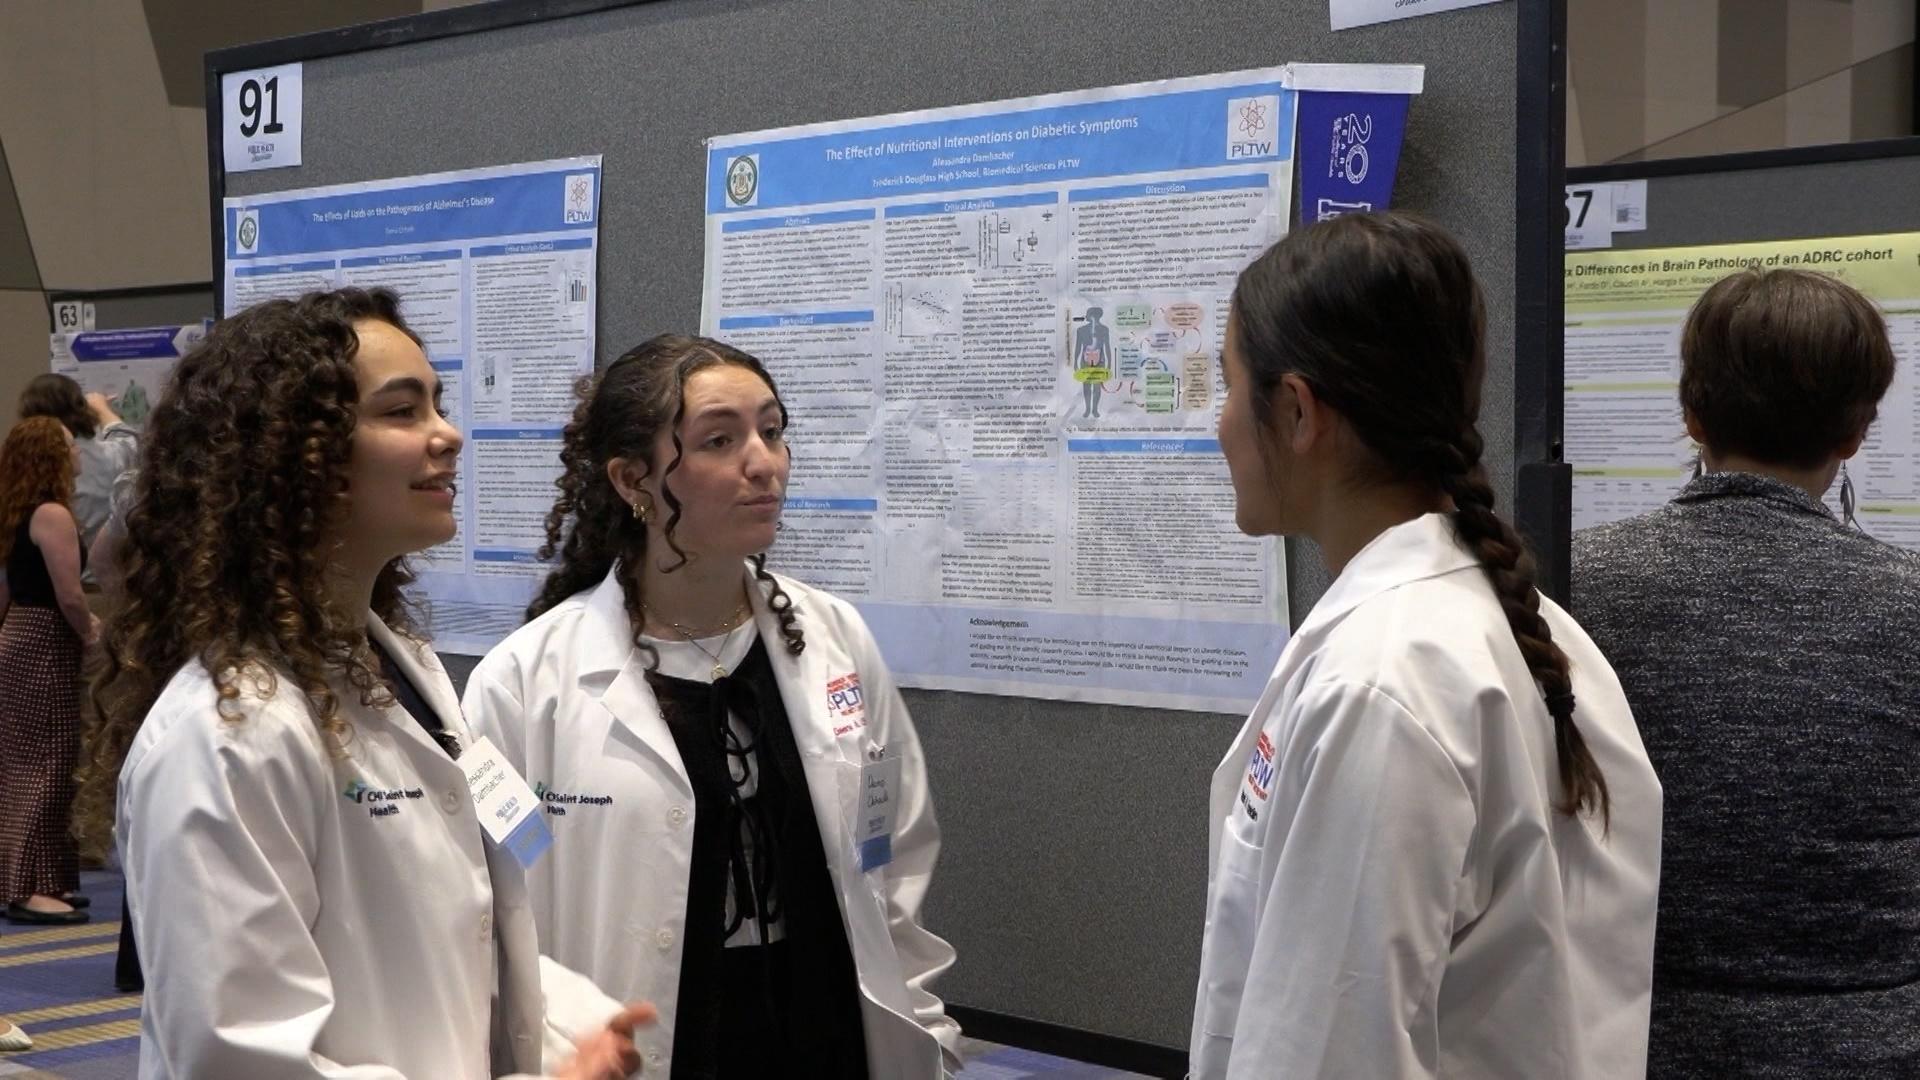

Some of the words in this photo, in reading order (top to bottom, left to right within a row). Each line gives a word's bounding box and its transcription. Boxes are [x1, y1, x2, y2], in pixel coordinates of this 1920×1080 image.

[239, 76, 283, 138] 91
[826, 148, 843, 161] The
[845, 146, 873, 160] Effect
[875, 144, 885, 156] of
[887, 137, 941, 154] Nutritional
[944, 130, 1013, 148] Interventions
[1016, 131, 1029, 141] on
[1032, 122, 1077, 138] Diabetic
[1079, 117, 1139, 136] Symptoms
[1232, 141, 1271, 157] PLTW
[1346, 113, 1372, 184] 20
[938, 171, 954, 183] High
[983, 164, 1024, 177] Biomedical
[1024, 163, 1056, 174] Sciences
[1057, 159, 1081, 170] PLTW
[1145, 184, 1186, 195] Discussion
[312, 212, 324, 223] The
[325, 209, 343, 222] Effects
[376, 206, 386, 217] the
[386, 203, 424, 216] Pathogenesis
[425, 200, 432, 212] of
[567, 209, 591, 222] PLTW
[1575, 263, 1646, 276] Differences
[1648, 261, 1660, 272] in
[1662, 259, 1696, 272] Brain
[1766, 253, 1780, 266] of
[1783, 254, 1800, 265] an
[1802, 250, 1843, 264] ADRC
[1846, 248, 1893, 262] cohort
[59, 305, 78, 326] 63
[1141, 442, 1185, 452] References
[579, 795, 613, 806] Joseph
